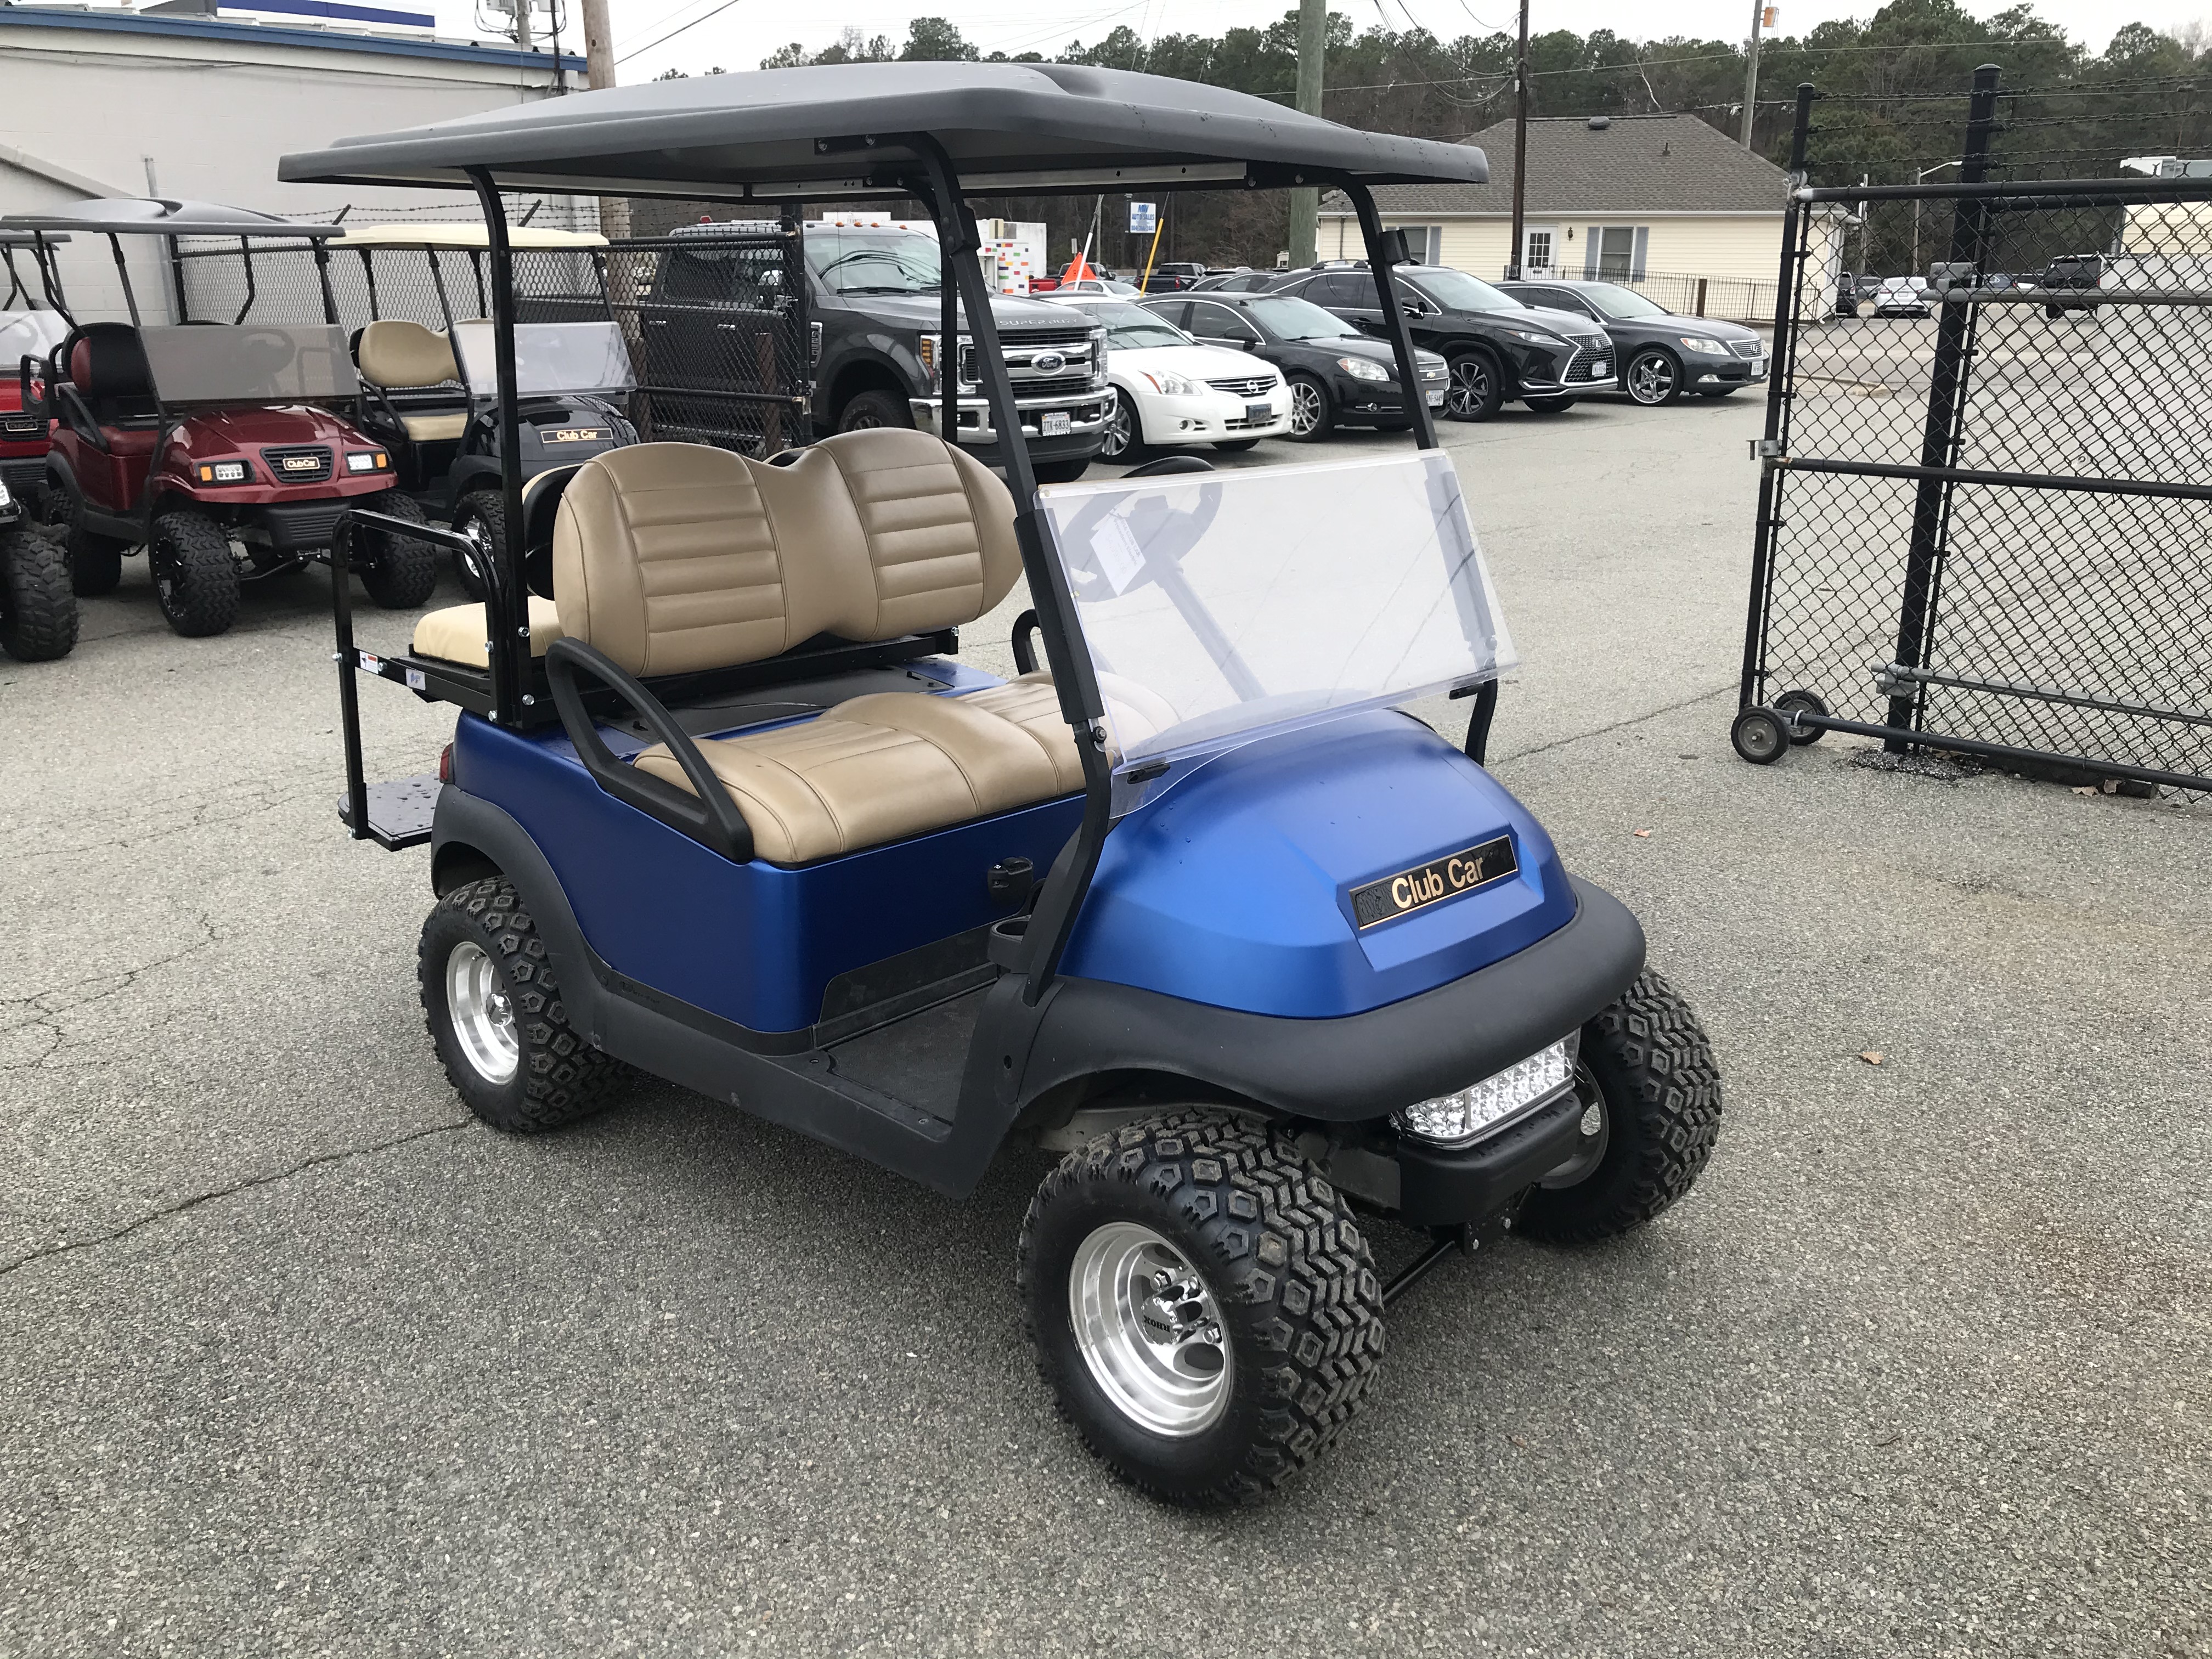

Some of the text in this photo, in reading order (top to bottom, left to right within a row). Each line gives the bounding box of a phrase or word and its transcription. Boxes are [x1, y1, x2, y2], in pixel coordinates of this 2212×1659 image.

[1042, 358, 1058, 368] Ford
[556, 430, 597, 441] Club Car
[1126, 531, 1135, 546] CLUB
[1133, 545, 1141, 557] CAR
[1392, 856, 1485, 909] Club Car
[1143, 1315, 1170, 1332] RHOX
